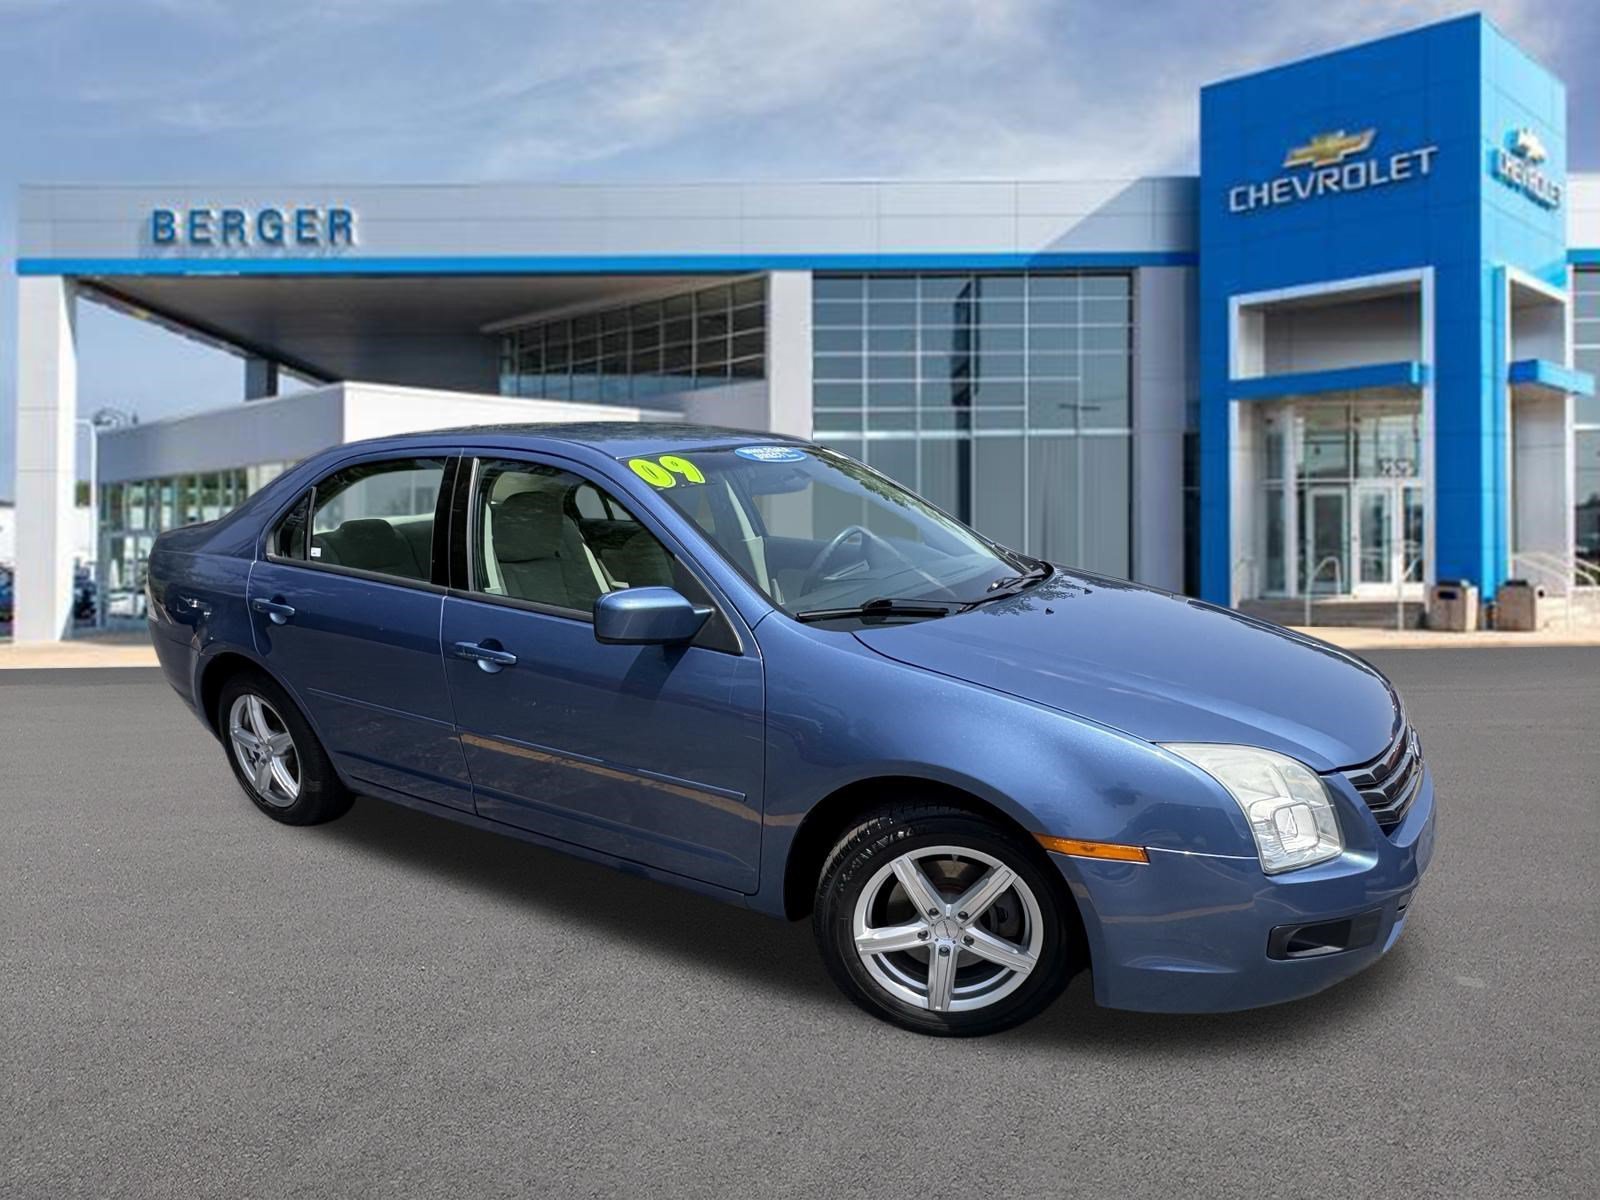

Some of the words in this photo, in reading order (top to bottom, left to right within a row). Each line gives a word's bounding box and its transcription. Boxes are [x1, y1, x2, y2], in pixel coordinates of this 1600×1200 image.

[1229, 146, 1438, 213] CHEVROLET
[151, 207, 356, 246] BERGER
[628, 455, 706, 489] 09
